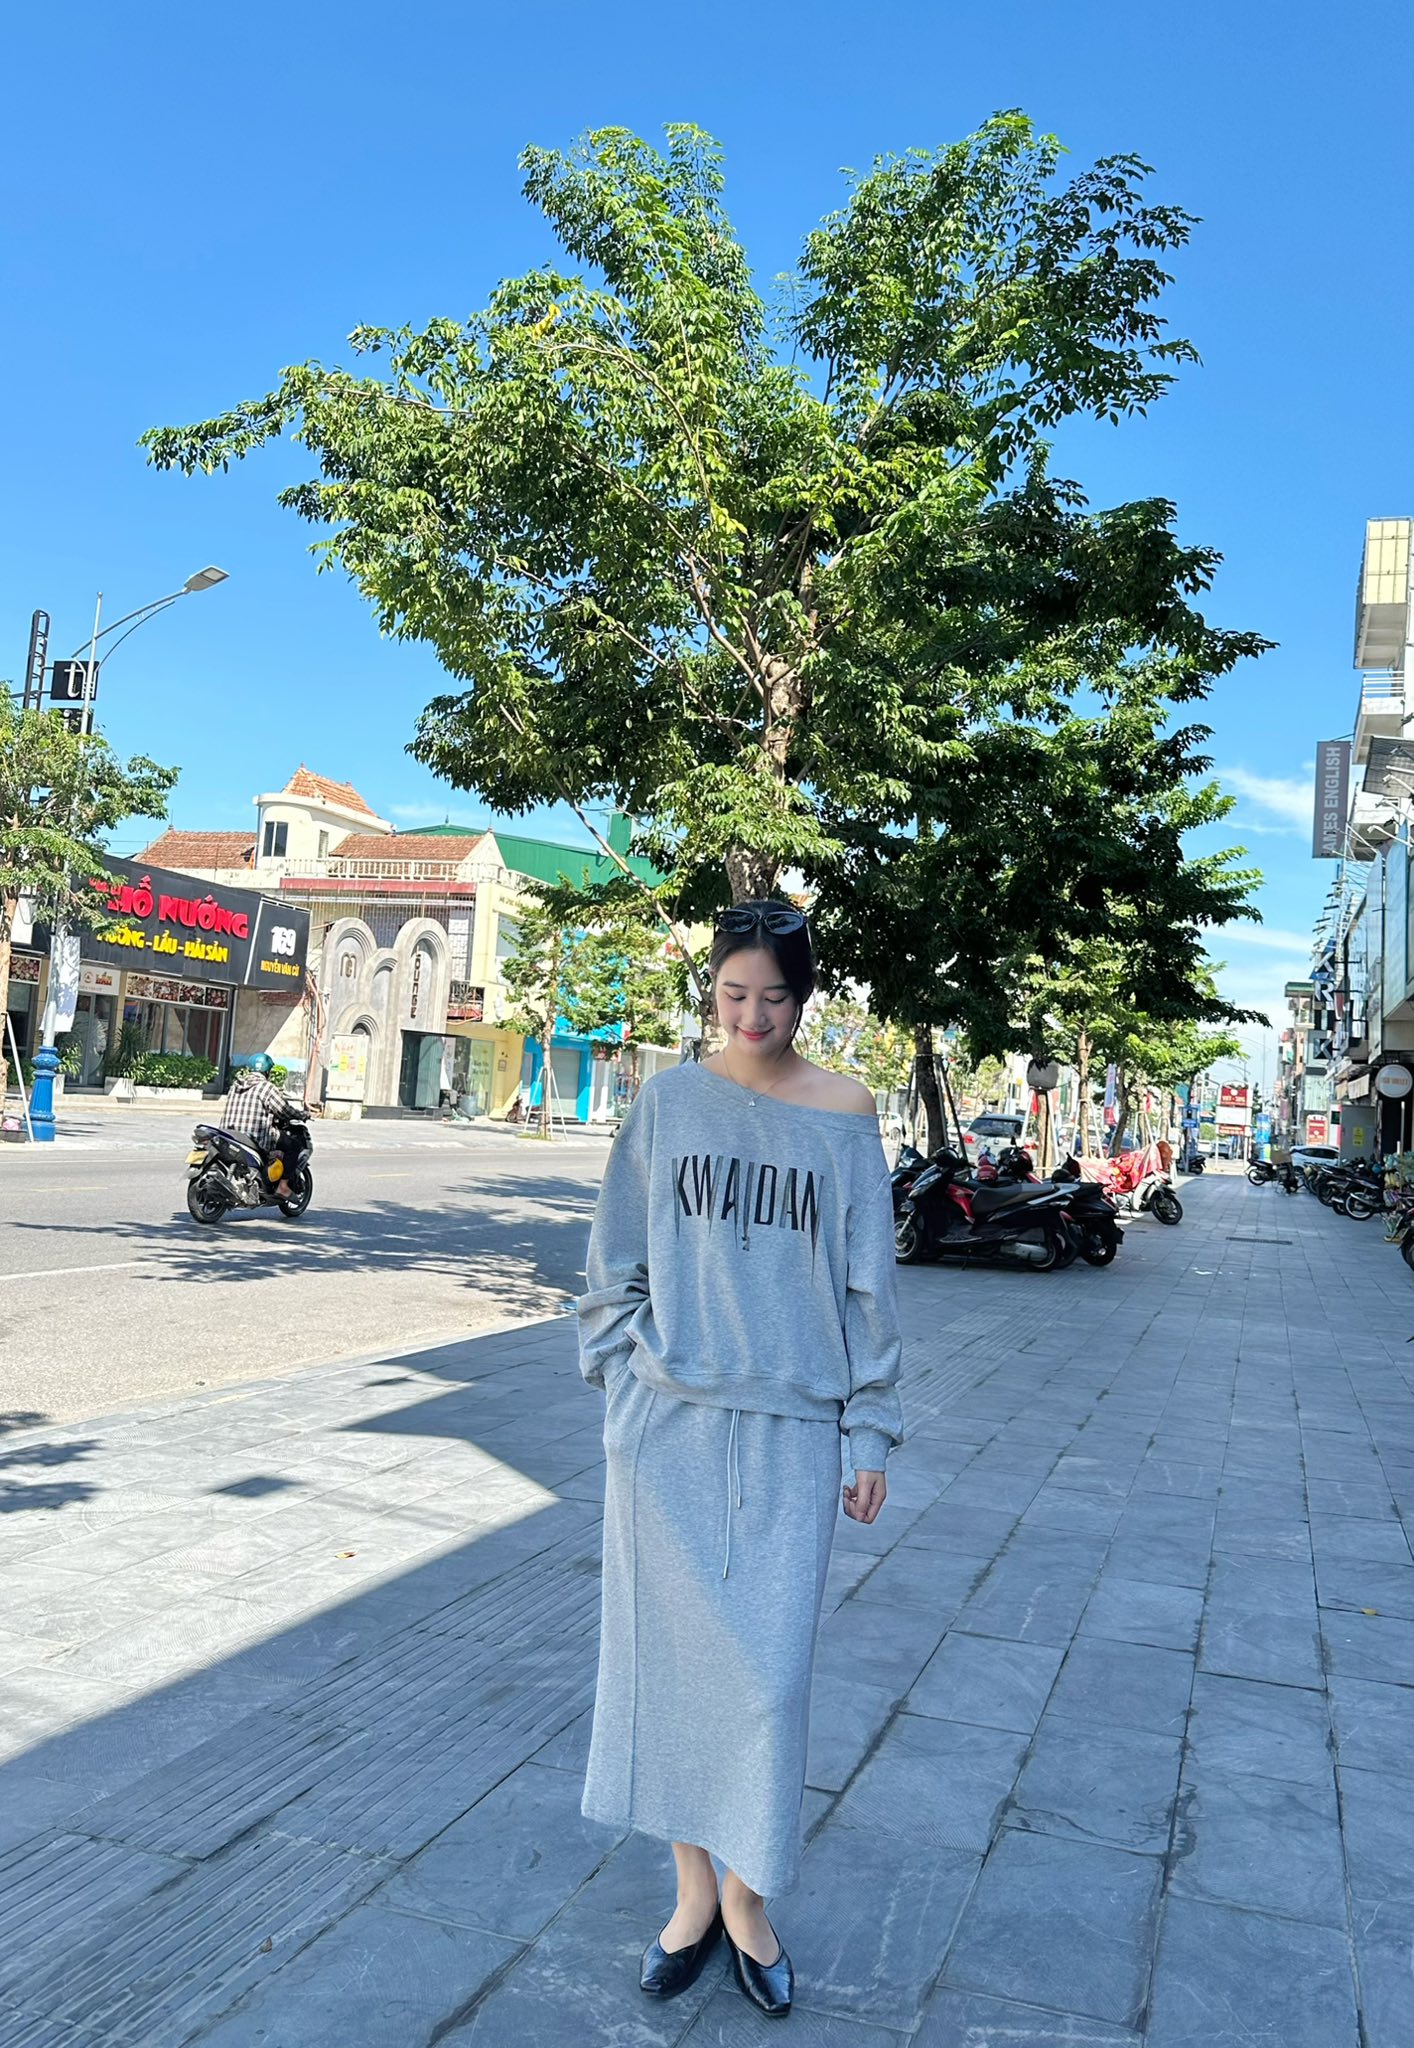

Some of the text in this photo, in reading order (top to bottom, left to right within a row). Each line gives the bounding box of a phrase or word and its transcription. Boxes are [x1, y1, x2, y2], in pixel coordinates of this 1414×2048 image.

[1325, 747, 1341, 808] ENGLISH
[158, 894, 249, 939] NƯỚNG
[271, 925, 296, 957] 169
[671, 1154, 825, 1262] KWAIDAN
